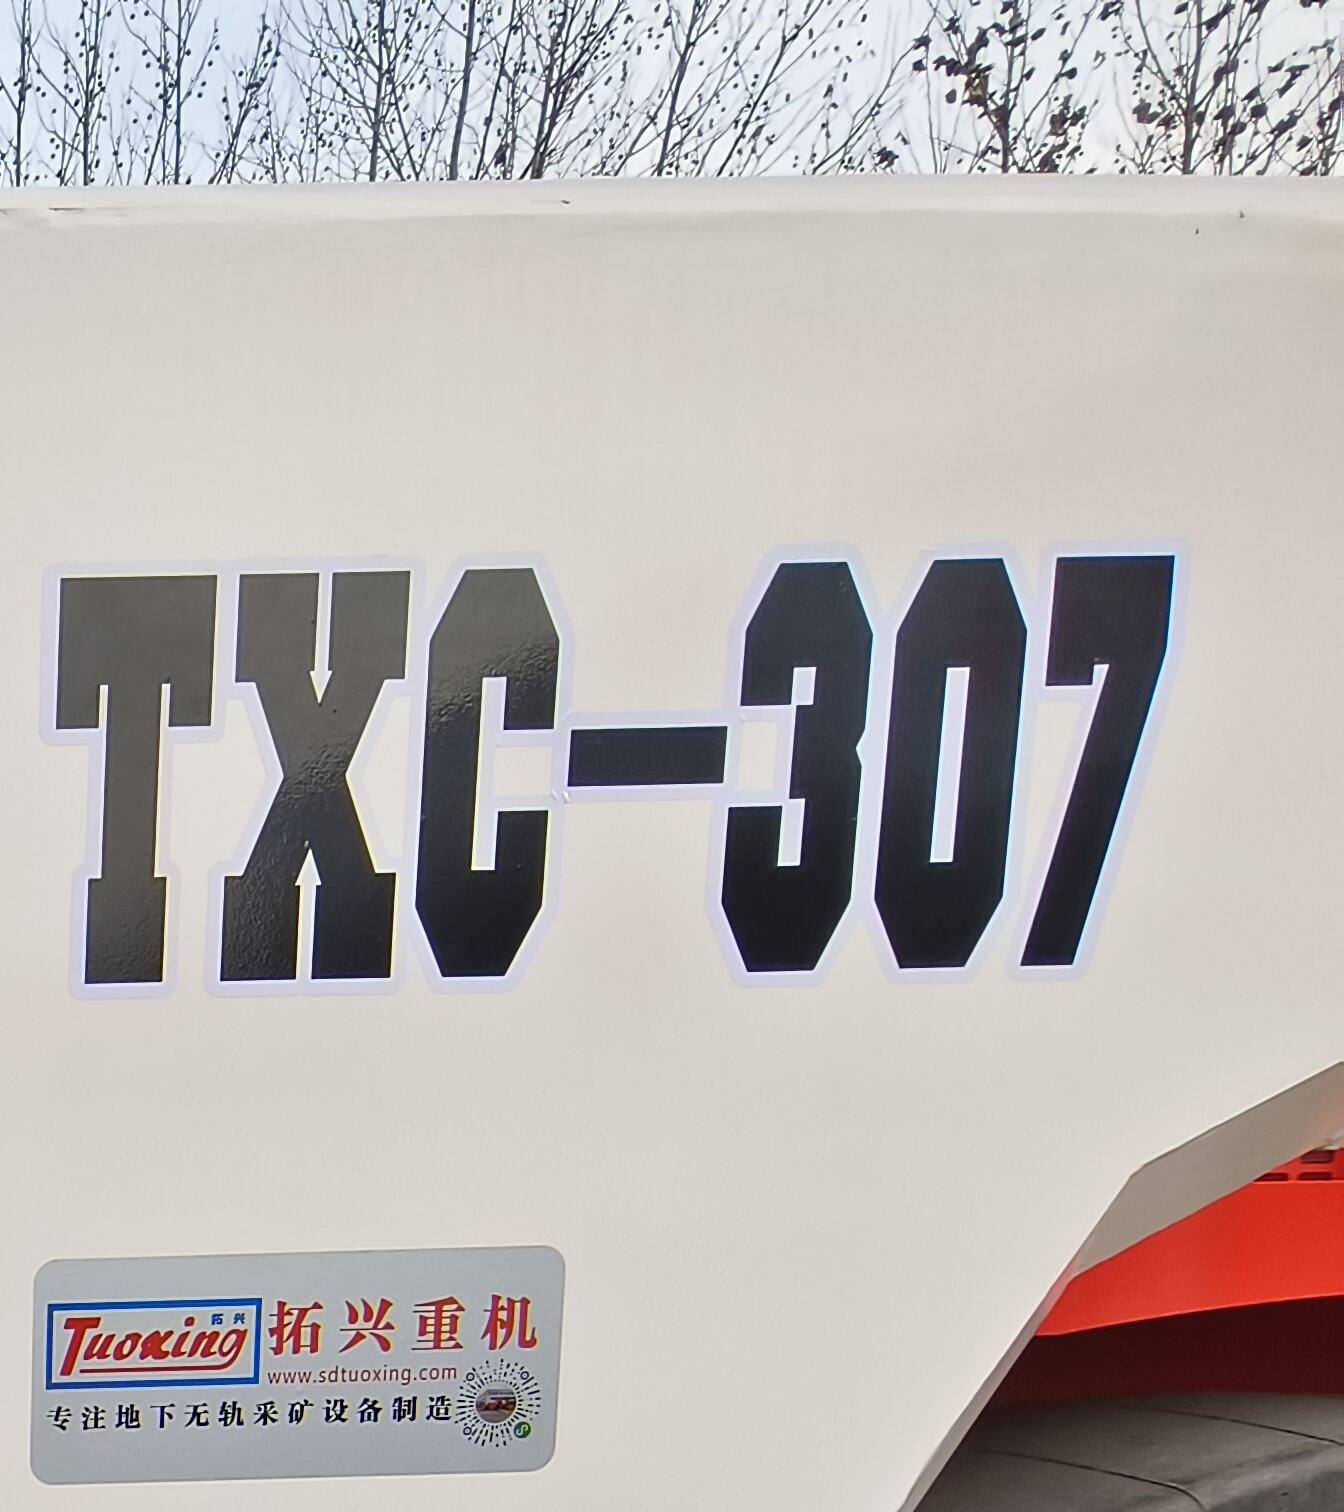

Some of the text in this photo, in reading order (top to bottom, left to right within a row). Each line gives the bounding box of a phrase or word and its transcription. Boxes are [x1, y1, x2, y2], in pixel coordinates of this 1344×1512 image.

[56, 555, 1176, 984] TXC-307
[59, 1315, 248, 1377] Tuoxing
[267, 1295, 539, 1357] 拓兴重机
[267, 1363, 458, 1386] www.sdtuoxing.com
[45, 1395, 454, 1431] 专注地下无轨采矿设备制造
